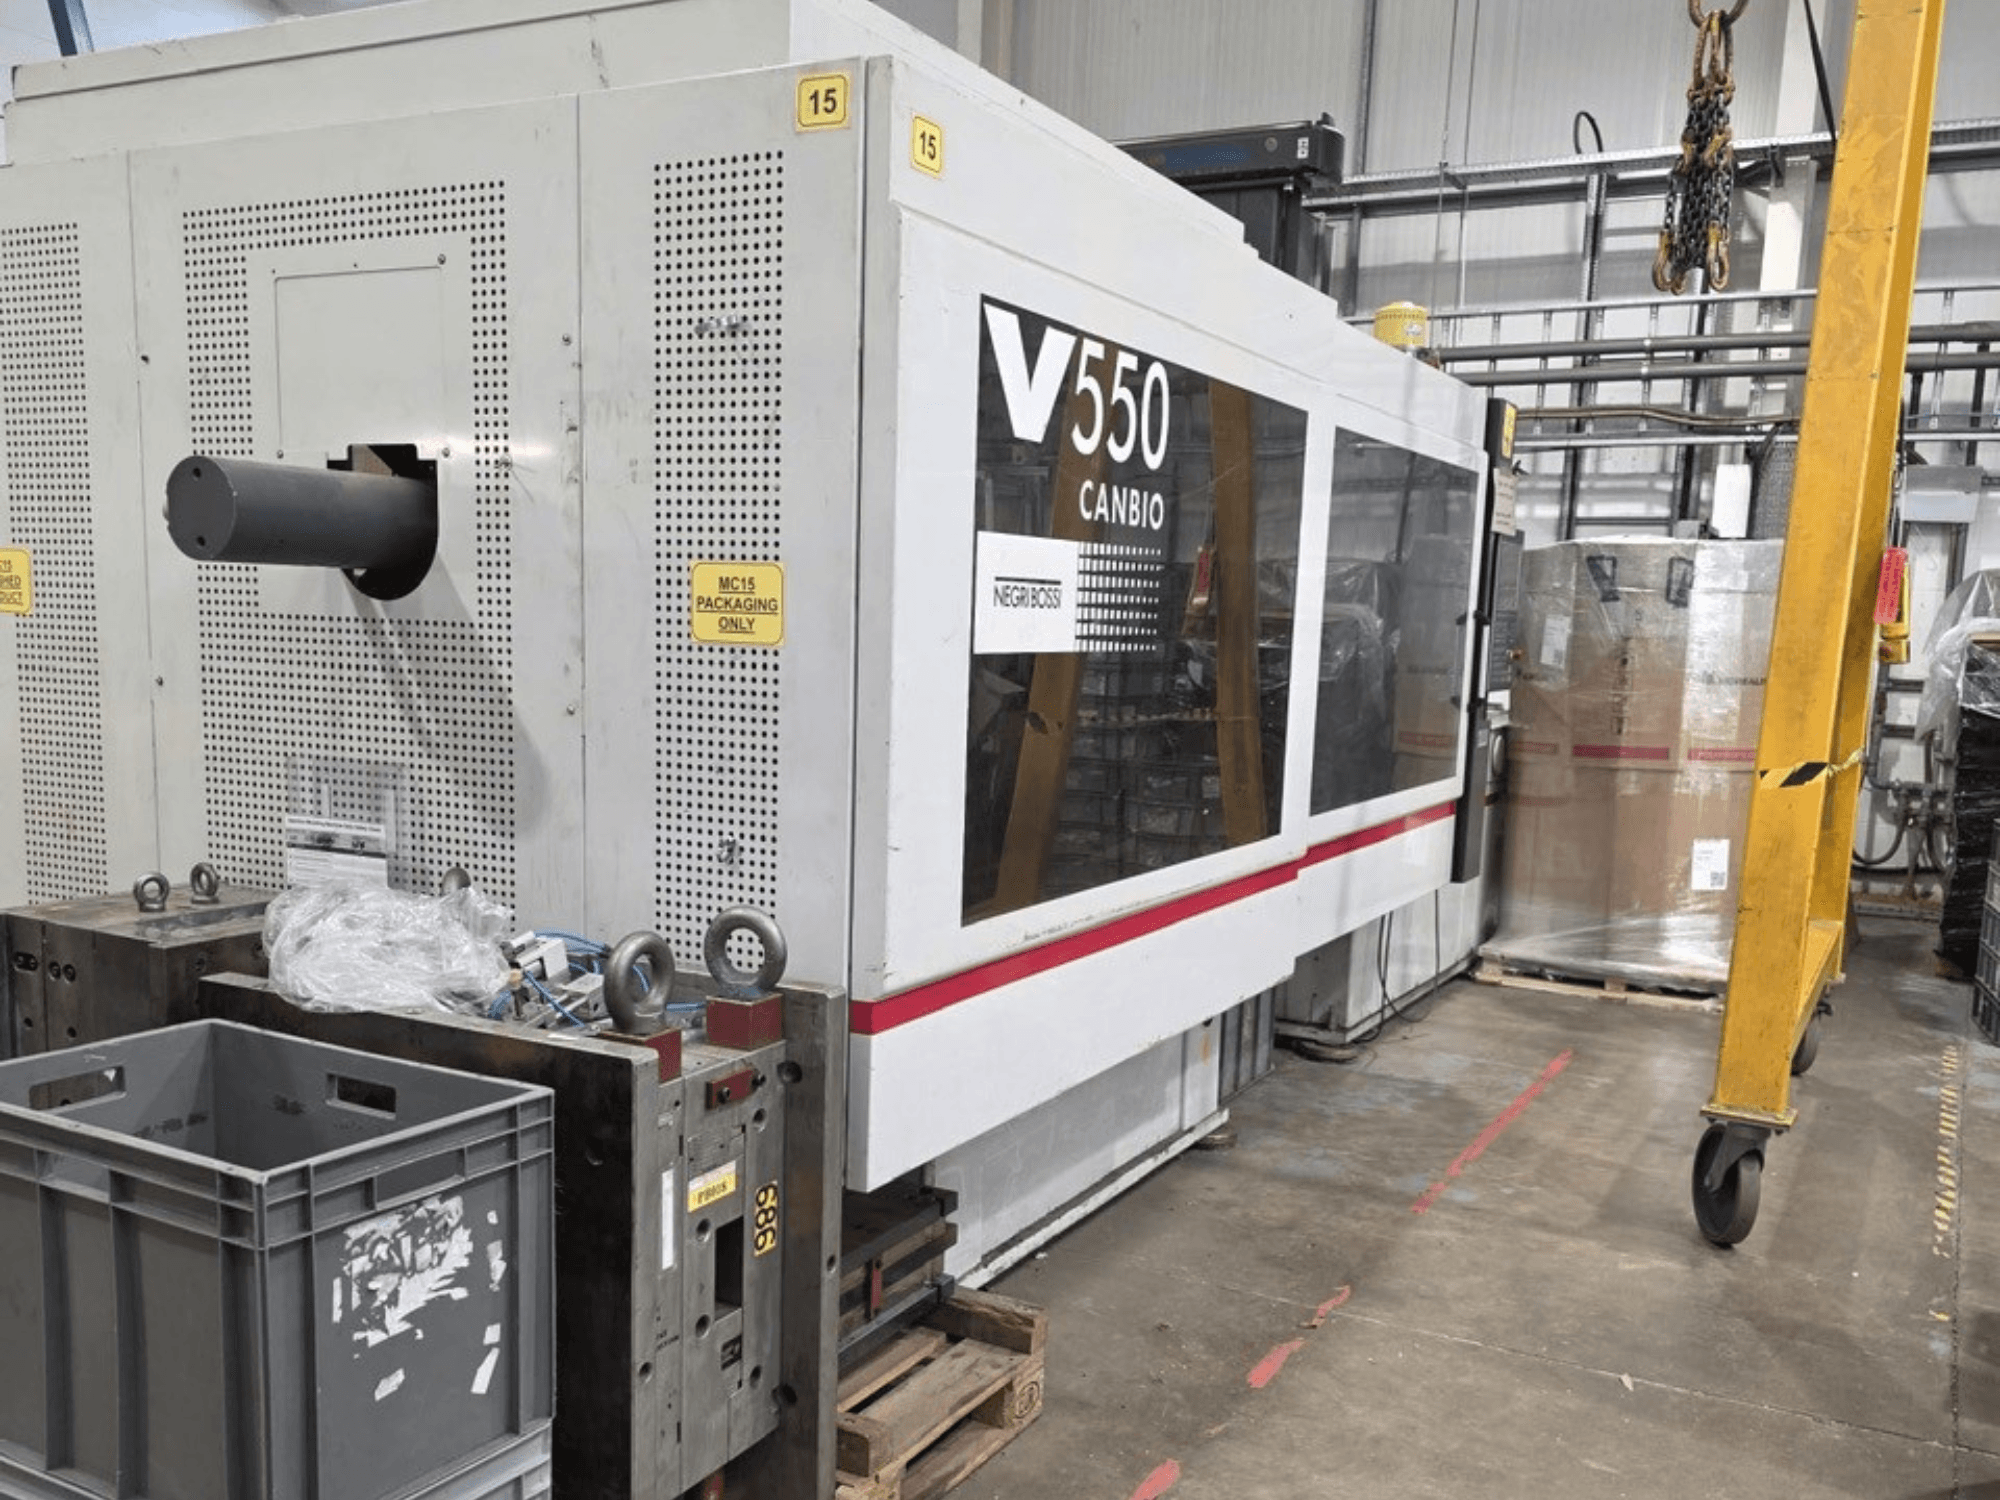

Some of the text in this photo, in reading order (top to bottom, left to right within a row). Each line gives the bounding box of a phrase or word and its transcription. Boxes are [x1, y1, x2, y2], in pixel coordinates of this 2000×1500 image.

[809, 88, 837, 115] 15
[919, 131, 936, 161] 15
[983, 302, 1169, 471] V550
[1078, 479, 1164, 530] CANBIO
[718, 576, 755, 590] MC15
[696, 595, 778, 611] PACKAGING
[718, 616, 755, 630] ONLY
